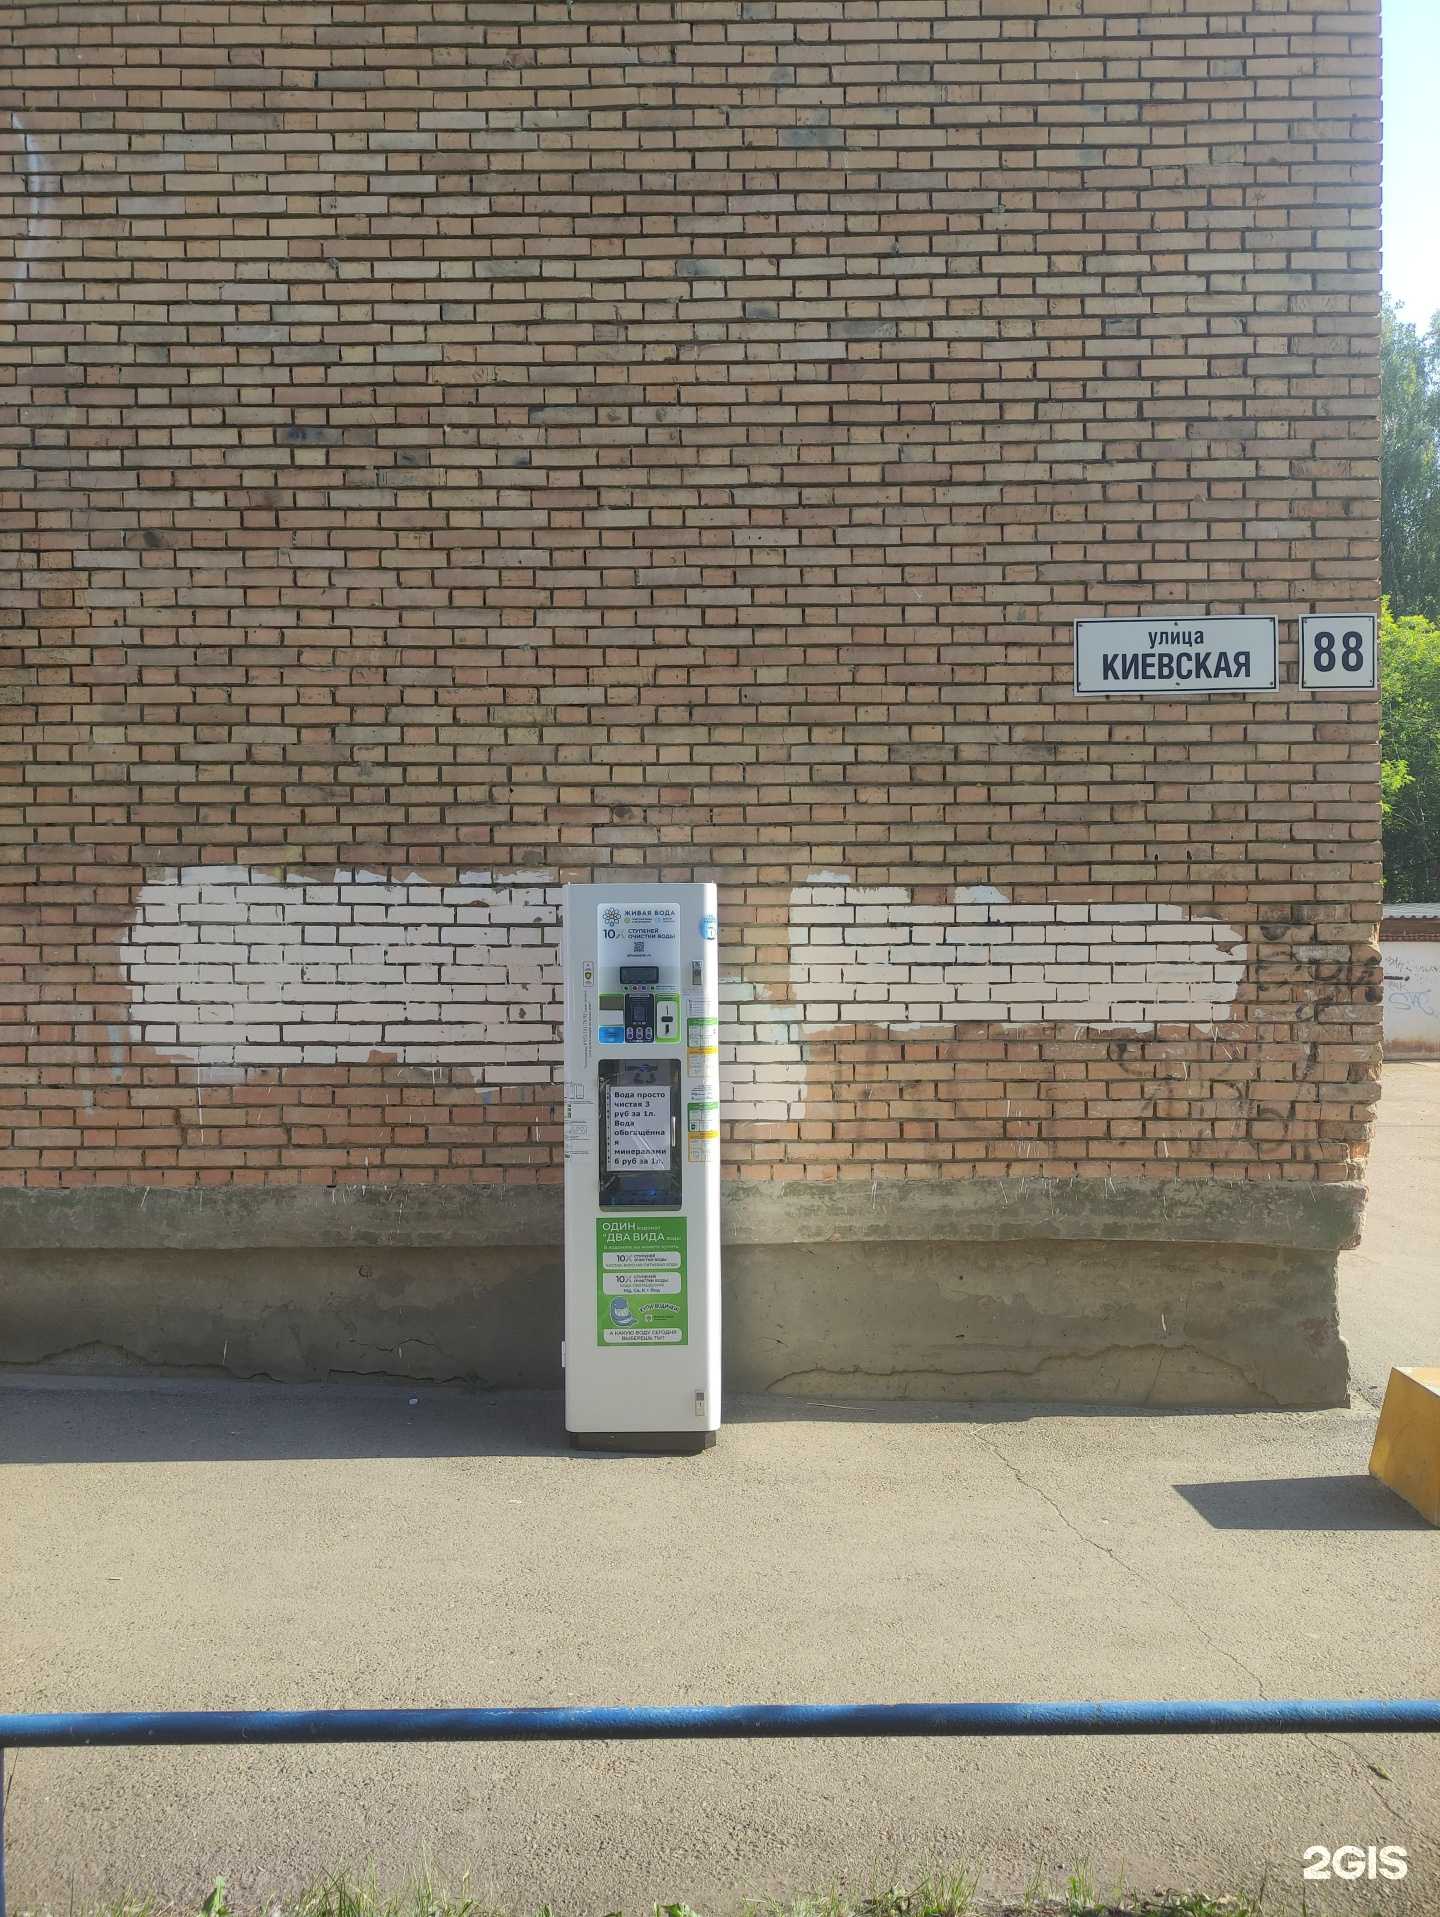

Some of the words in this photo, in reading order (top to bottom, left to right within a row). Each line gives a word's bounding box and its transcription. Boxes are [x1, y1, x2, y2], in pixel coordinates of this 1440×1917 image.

[1148, 630, 1204, 649] улица
[1313, 631, 1364, 672] 88
[1102, 651, 1251, 680] КИЕВСКАЯ
[603, 929, 616, 939] 10
[614, 1110, 630, 1118] руб
[622, 1157, 637, 1166] руб
[602, 1222, 636, 1233] ОДИН
[606, 1232, 631, 1243] ДВА
[633, 1231, 665, 1243] ВИДА
[616, 1254, 626, 1263] 10
[616, 1275, 626, 1283] 10
